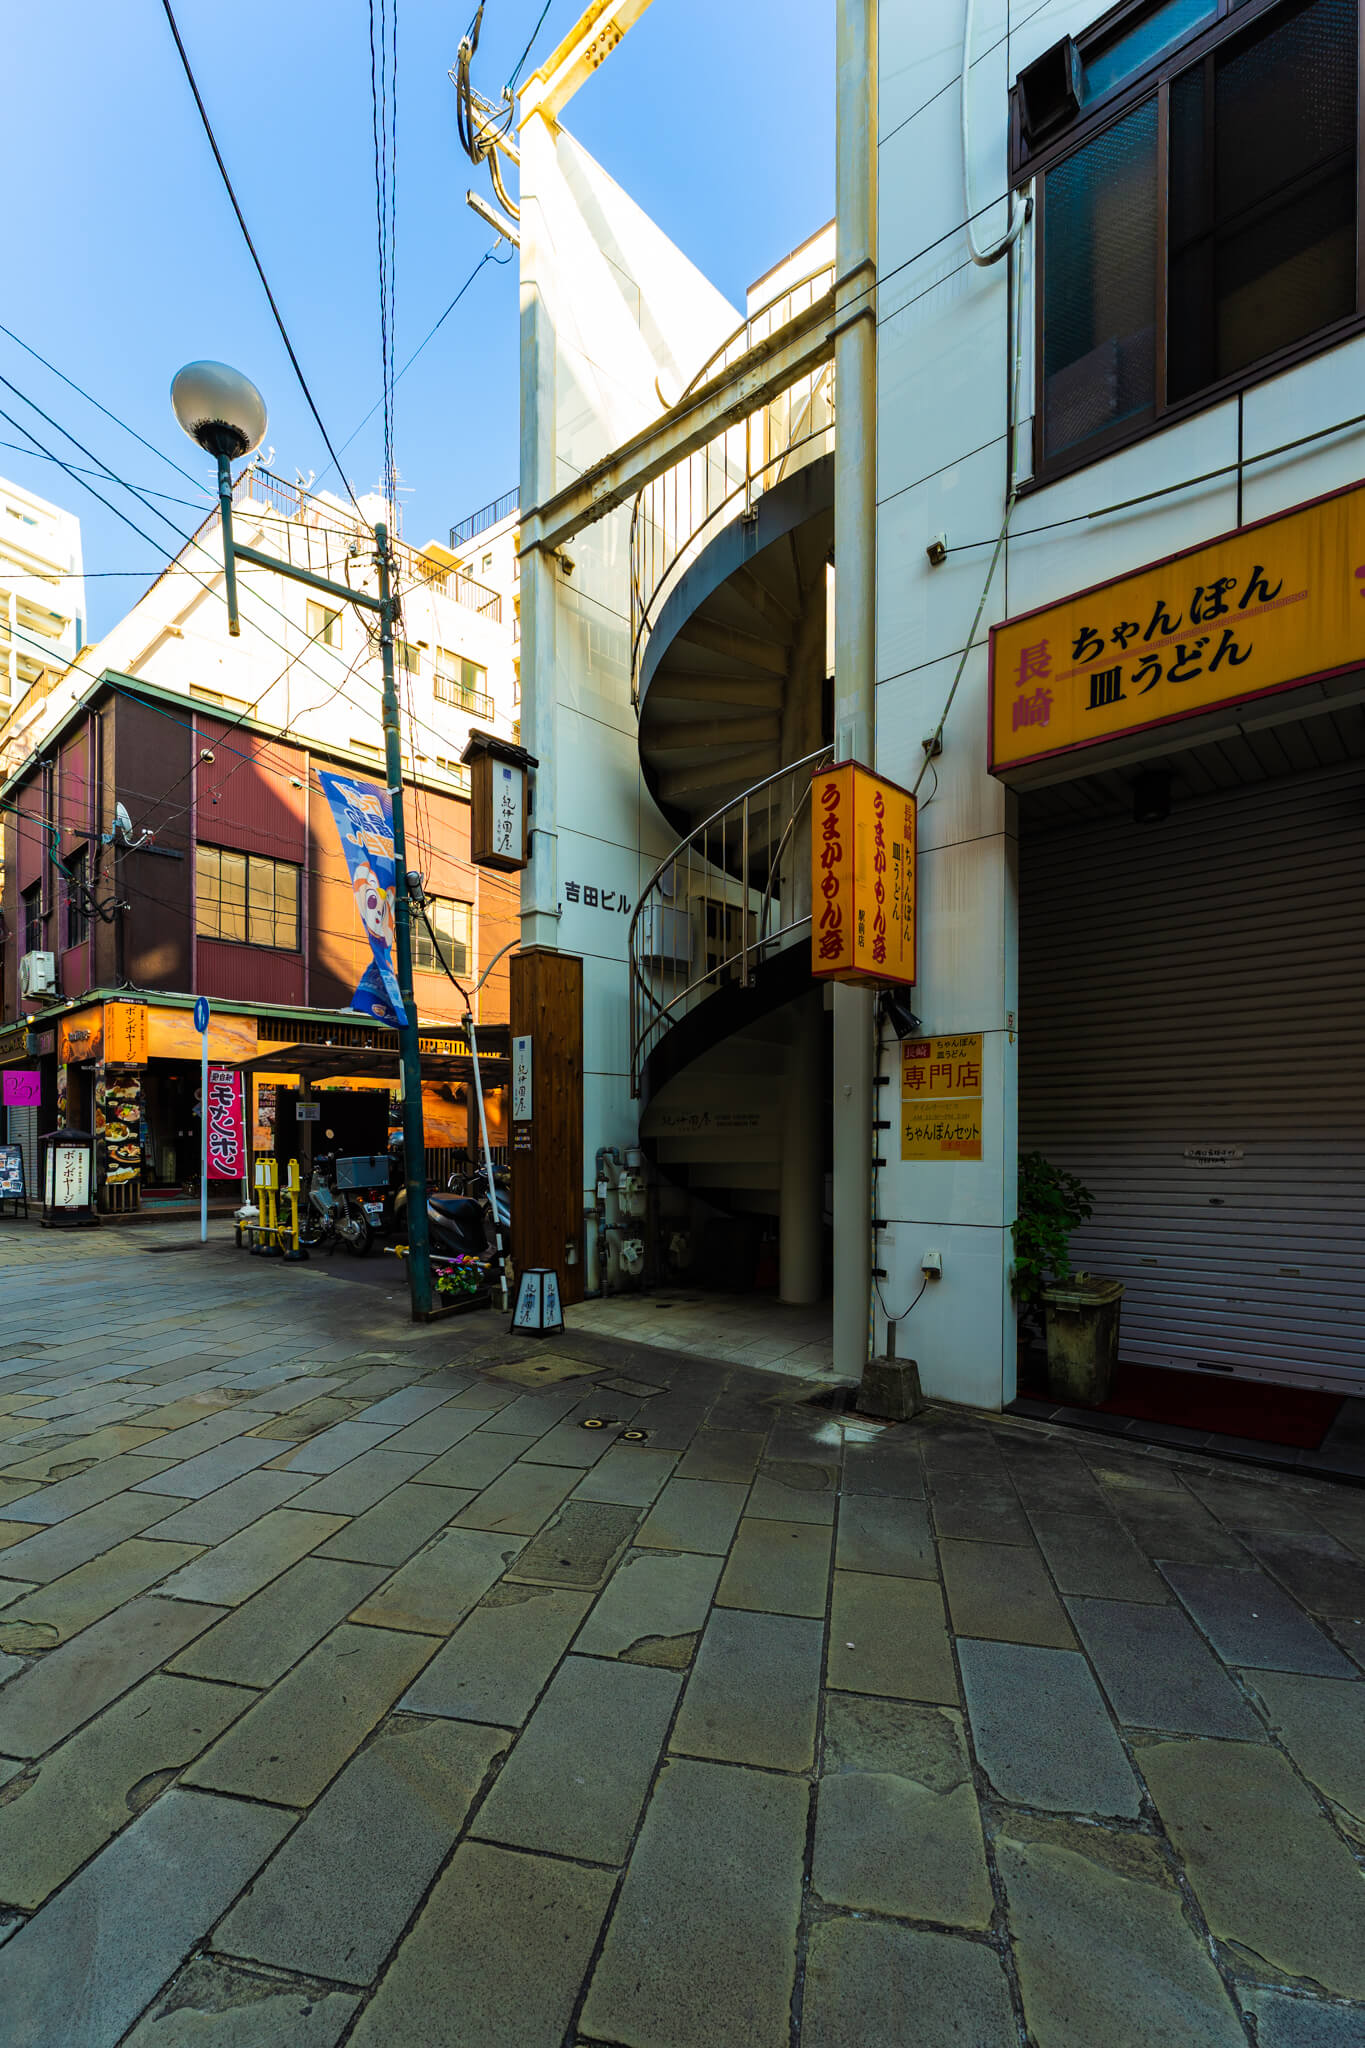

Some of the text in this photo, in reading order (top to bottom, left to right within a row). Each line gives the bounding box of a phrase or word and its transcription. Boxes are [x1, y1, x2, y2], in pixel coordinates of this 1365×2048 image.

[1071, 565, 1283, 665] ちゃんぽん
[1012, 638, 1054, 732] 長崎
[1084, 629, 1253, 711] 皿うどん
[564, 880, 632, 915] 吉田ビル
[892, 841, 901, 922] 皿うどん
[903, 1061, 981, 1091] 専門店
[905, 1045, 928, 1058] 長崎
[936, 1049, 967, 1060] 皿うどん
